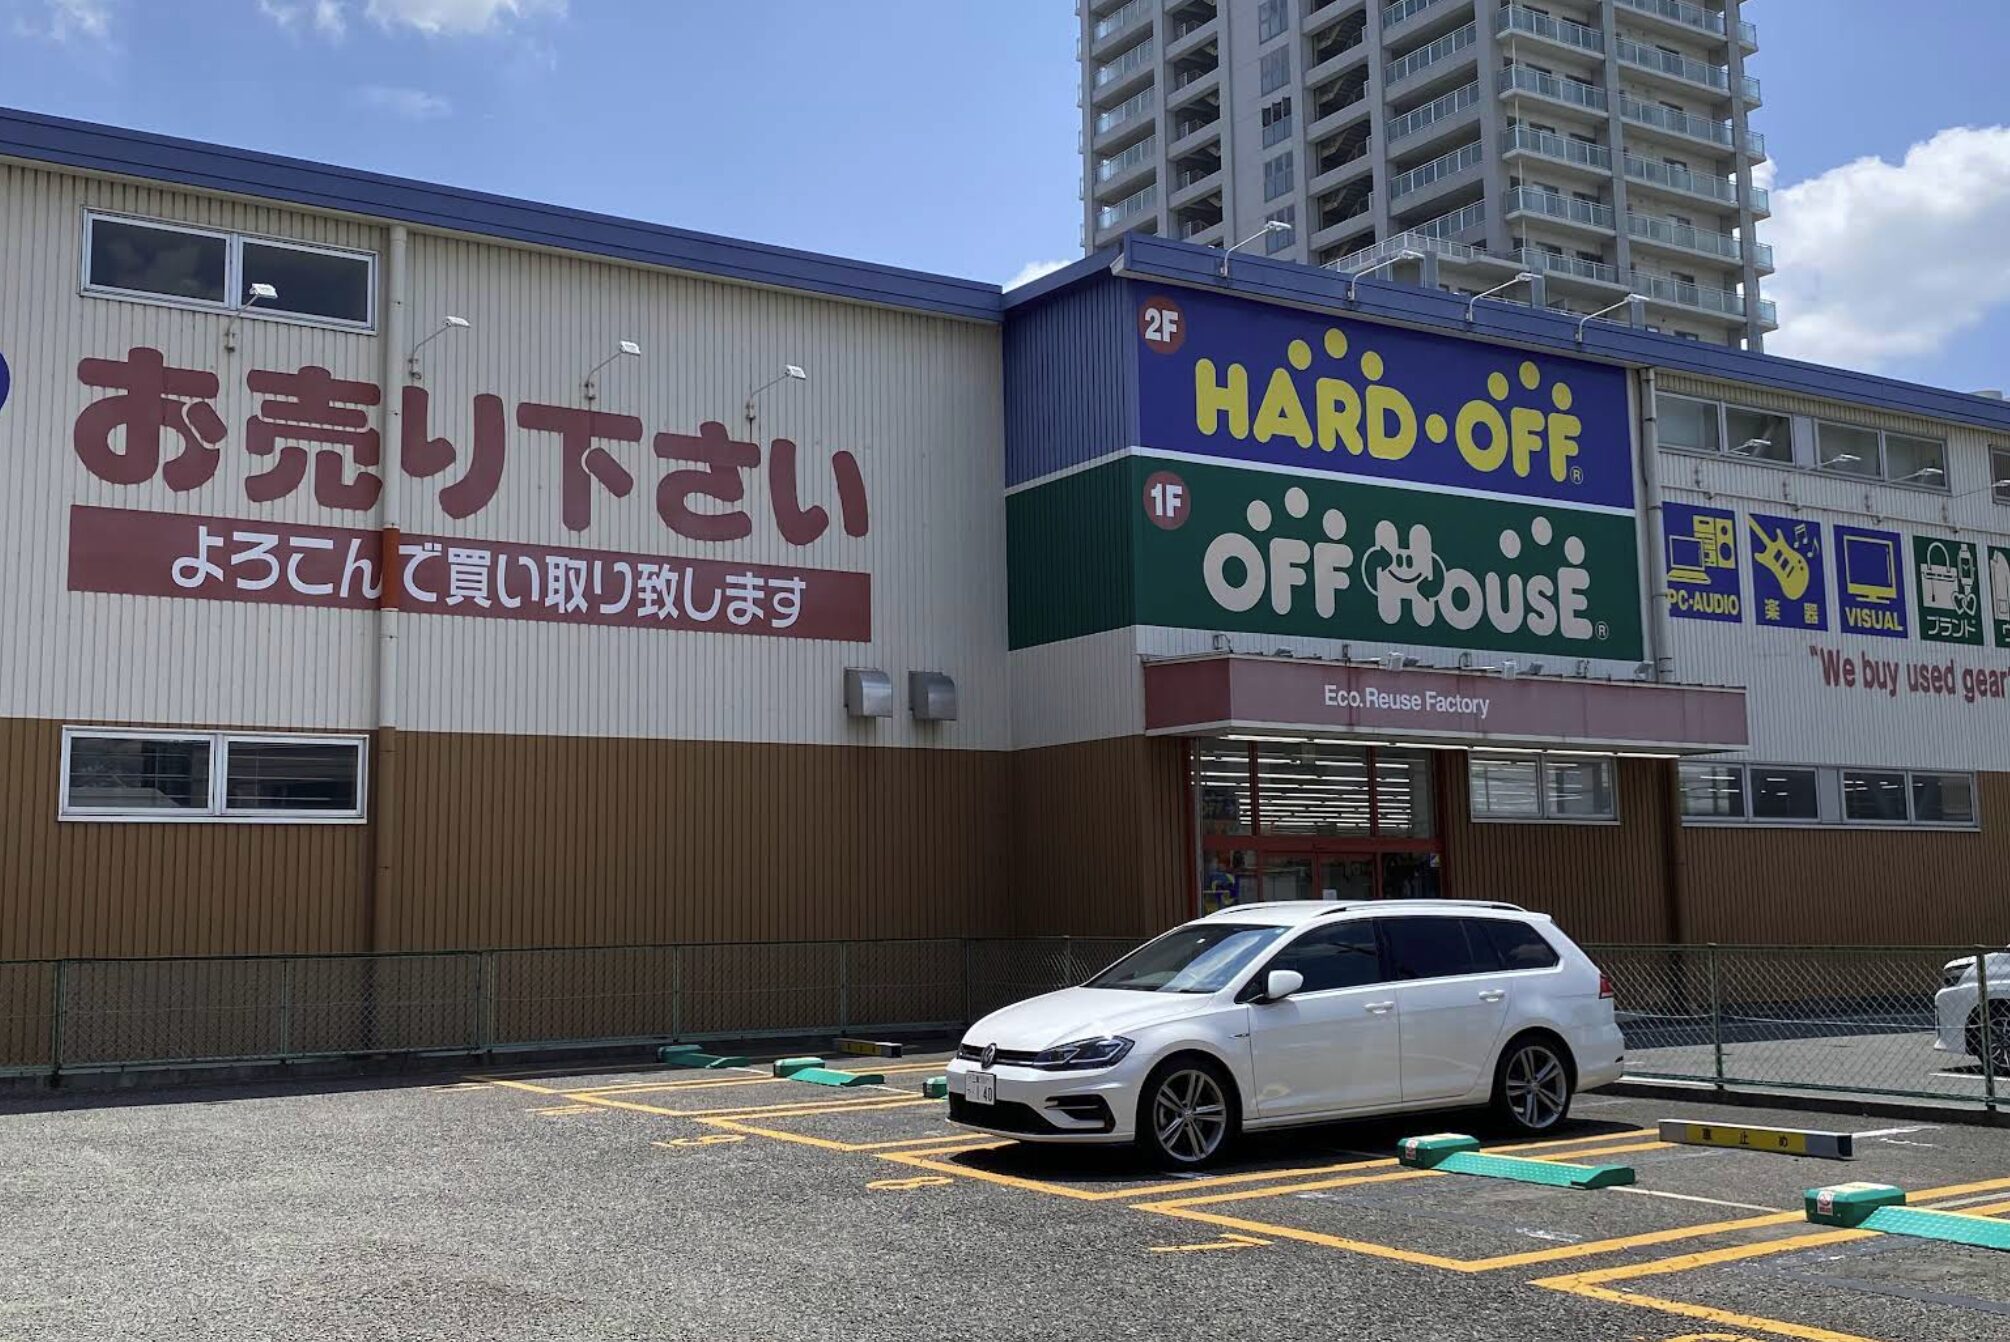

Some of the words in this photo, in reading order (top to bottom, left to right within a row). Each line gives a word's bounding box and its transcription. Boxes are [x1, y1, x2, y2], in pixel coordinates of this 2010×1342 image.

[1144, 307, 1179, 343] 2F
[73, 347, 869, 546] お売り下さい
[1150, 483, 1183, 517] 1F
[171, 525, 806, 629] よろこんで買い取り致します
[1203, 532, 1354, 619] OFF
[1375, 519, 1593, 640] HOUSE
[1845, 606, 1904, 631] VISUAL
[1861, 650, 1900, 698] buy
[1906, 658, 1957, 695] used
[1425, 690, 1490, 719] Factory
